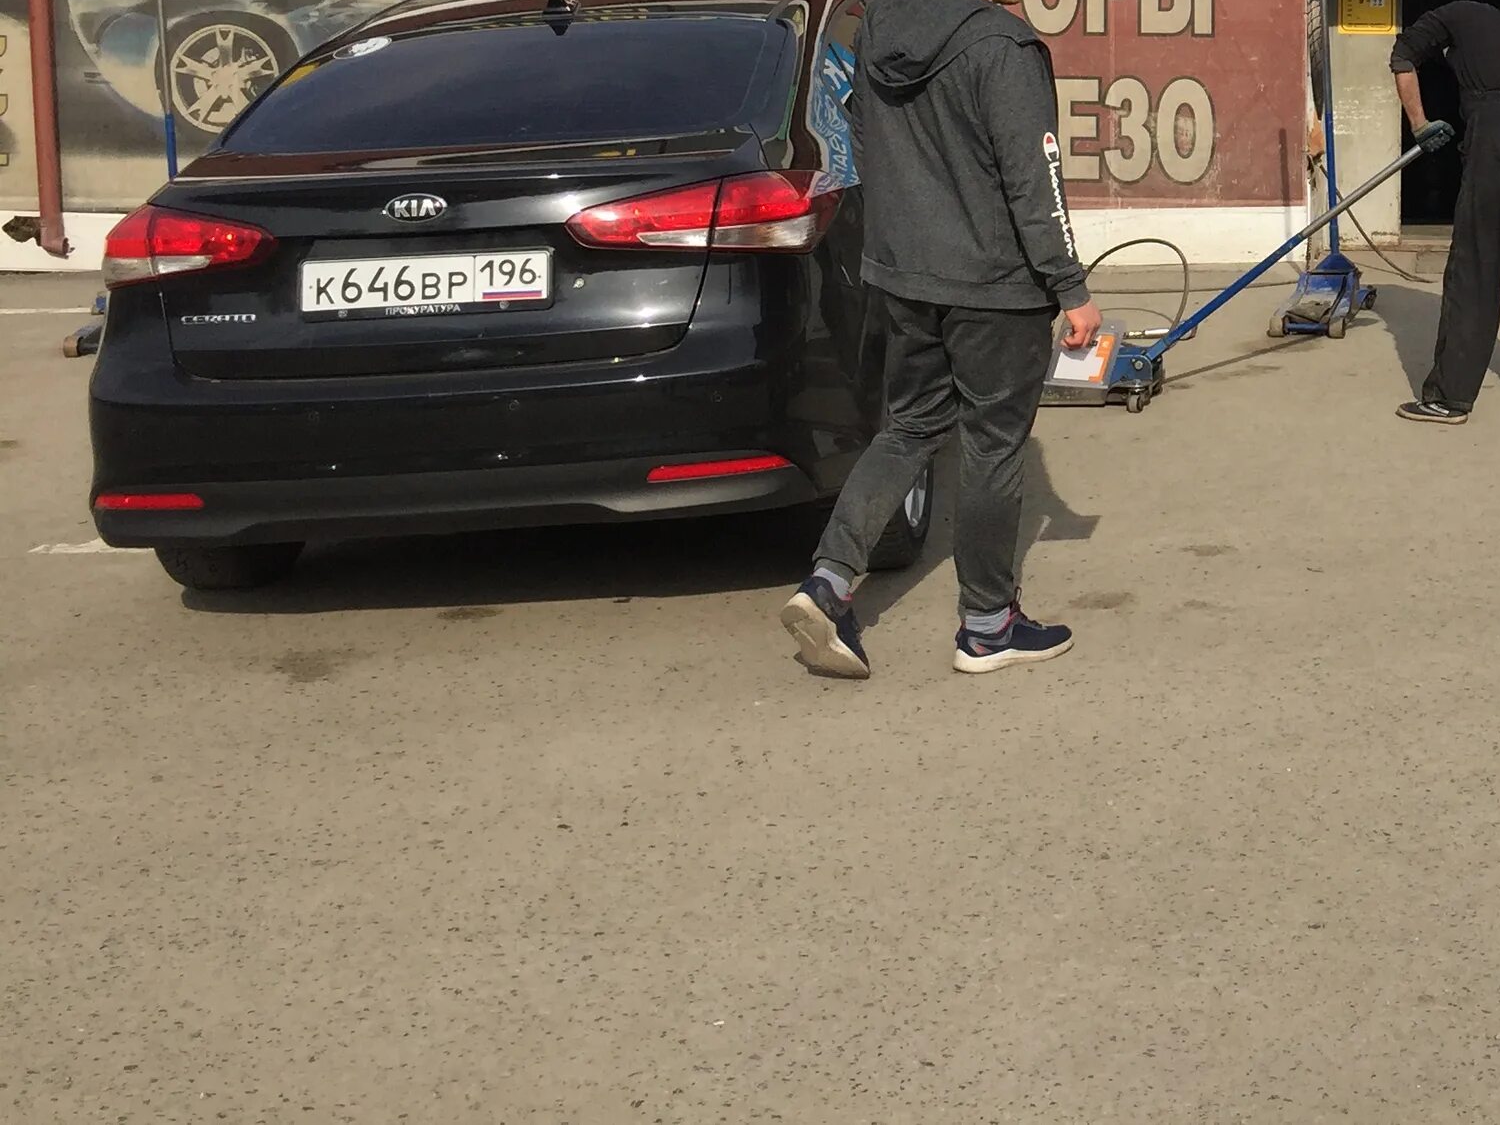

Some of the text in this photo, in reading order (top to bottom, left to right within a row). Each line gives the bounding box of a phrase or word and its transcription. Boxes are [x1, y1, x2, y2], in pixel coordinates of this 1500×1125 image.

[1043, 131, 1074, 258] Champion
[394, 199, 437, 217] KIA
[480, 257, 538, 286] 196
[385, 303, 461, 316] ПРОКУРАТУРА
